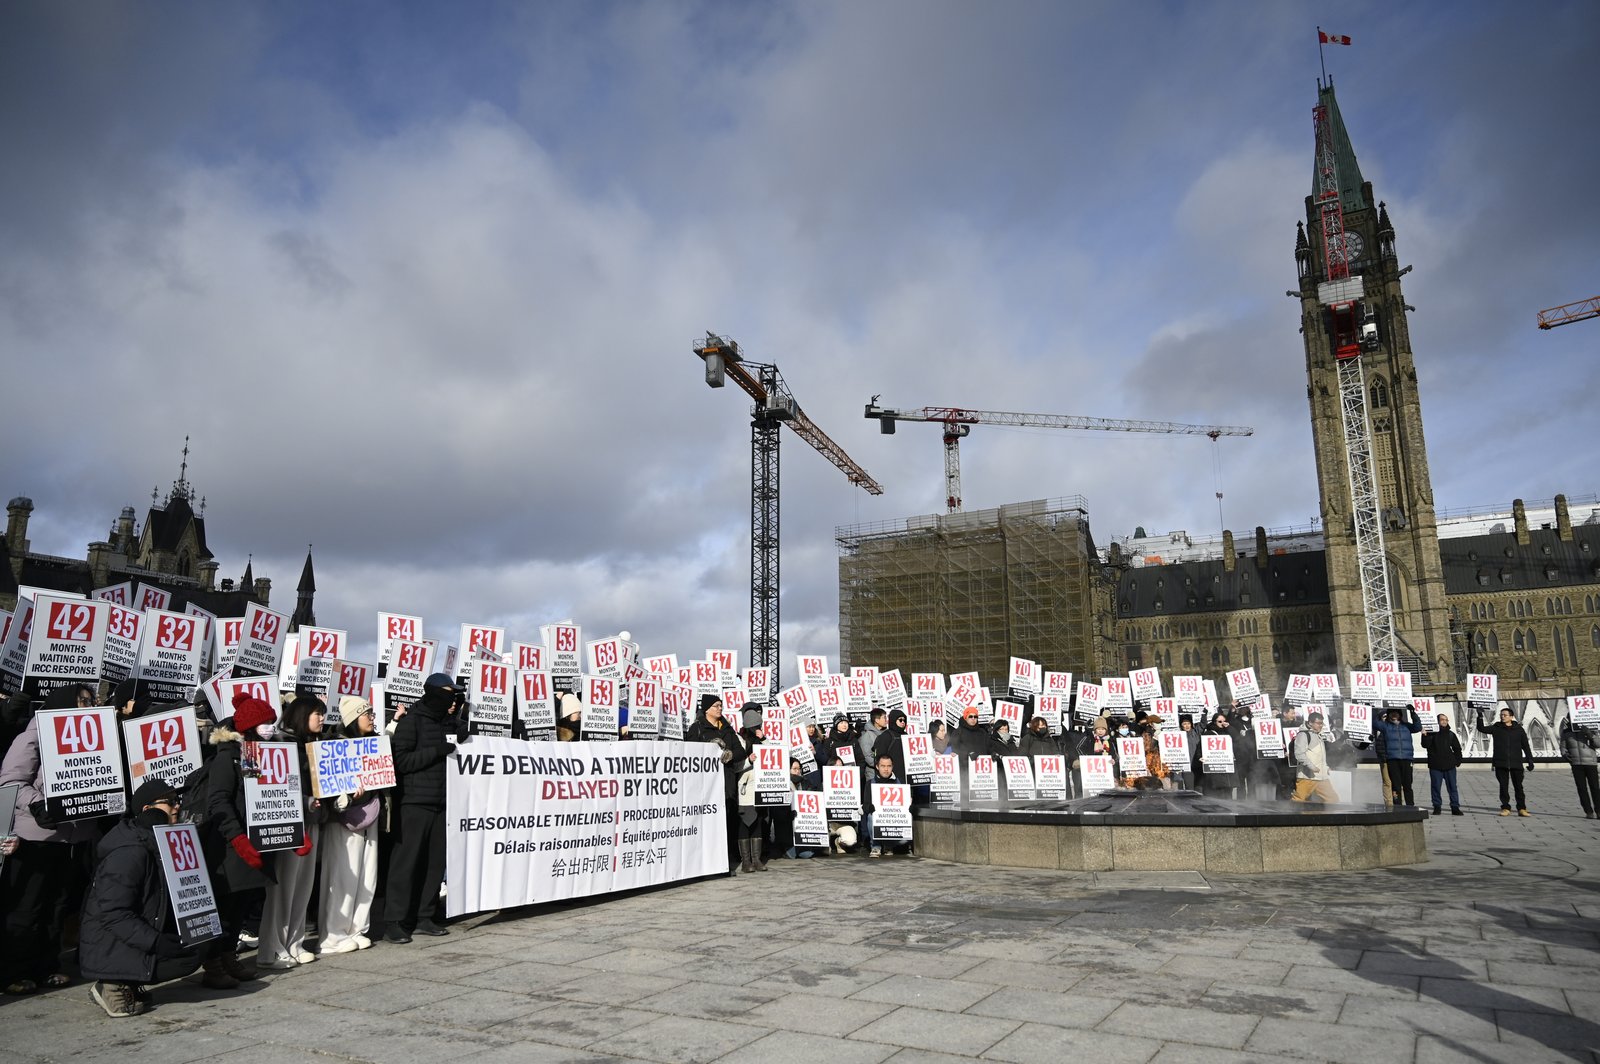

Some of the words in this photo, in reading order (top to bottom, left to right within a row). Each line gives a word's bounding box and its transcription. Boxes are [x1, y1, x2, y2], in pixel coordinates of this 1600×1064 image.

[53, 604, 90, 640] 42
[109, 608, 135, 639] 35
[254, 612, 277, 643] 42
[390, 618, 412, 641] 34
[161, 617, 190, 650] 32
[473, 629, 493, 652] 31
[559, 628, 575, 652] 53
[50, 643, 86, 654] MONTHS
[107, 636, 131, 649] MONTHS
[251, 641, 272, 654] MONTHS
[312, 632, 335, 658] 22
[40, 653, 75, 664] WAITING
[77, 656, 93, 665] FOR
[107, 653, 134, 666] RESPONS
[124, 650, 136, 659] FOR
[158, 651, 186, 662] MONTHS
[244, 648, 265, 660] WAITING
[265, 654, 275, 664] FOR
[401, 645, 421, 672] 31
[522, 646, 537, 670] 15
[597, 642, 616, 667] 68
[32, 664, 52, 673] IRCC
[52, 664, 96, 675] RESPONSE
[149, 660, 179, 671] WAITING
[180, 663, 192, 672] FOR
[238, 655, 250, 665] IRCC
[250, 659, 276, 672] RESPONSE
[304, 667, 327, 676] WAITING
[653, 659, 671, 674] 20
[807, 659, 821, 674] 43
[1016, 661, 1030, 677] 70
[143, 668, 159, 677] IRCC
[159, 669, 195, 681] RESPONSE
[300, 675, 312, 683] IRCC
[341, 666, 361, 695] 31
[399, 670, 419, 680] MONTHS
[484, 665, 503, 694] 11
[699, 664, 716, 681] 33
[749, 670, 765, 688] 38
[1234, 671, 1251, 686] 38
[1358, 674, 1375, 687] 20
[1388, 674, 1405, 687] 31
[388, 683, 400, 691] IRCC
[399, 685, 424, 695] RESPONSE
[392, 677, 412, 686] WAITING
[526, 675, 545, 700] 71
[849, 681, 865, 697] 65
[884, 673, 899, 690] 63
[919, 676, 935, 690] 27
[1051, 674, 1066, 689] 36
[1111, 680, 1124, 694] 37
[1294, 676, 1309, 689] 32
[1474, 676, 1491, 689] 30
[592, 680, 611, 706] 53
[638, 682, 654, 706] 34
[728, 691, 744, 709] 34
[786, 687, 806, 708] 30
[821, 689, 837, 706] 55
[955, 685, 976, 706] 35
[1083, 685, 1097, 700] 28
[663, 692, 678, 716] 51
[908, 700, 921, 716] 72
[930, 702, 943, 718] 23
[1041, 697, 1056, 712] 31
[1158, 700, 1172, 714] 31
[1415, 699, 1430, 712] 37
[1575, 697, 1594, 710] 23
[1003, 704, 1017, 720] 11
[1351, 705, 1366, 720] 40
[61, 715, 99, 752] 40
[765, 721, 782, 740] 33
[1262, 721, 1276, 736] 37
[147, 718, 182, 757] 42
[1166, 733, 1181, 748] 37
[1210, 737, 1225, 751] 37
[321, 740, 349, 759] STOP
[353, 738, 378, 756] THE
[910, 737, 927, 755] 34
[1125, 740, 1139, 755] 37
[64, 755, 102, 768] MONTHS
[150, 755, 184, 771] MONTHS
[261, 748, 287, 784] 40
[457, 754, 495, 776] WE
[502, 754, 585, 777] DEMAND
[590, 757, 603, 775] A
[605, 756, 660, 775] TIMELY
[663, 756, 720, 774] DECISION
[762, 749, 780, 770] 41
[937, 758, 953, 774] 35
[976, 758, 991, 774] 18
[1010, 759, 1026, 774] 36
[1043, 758, 1058, 773] 21
[1089, 758, 1105, 773] 14
[56, 768, 93, 780] WAITING
[95, 765, 112, 776] FOR
[142, 768, 177, 782] WAITING
[178, 762, 194, 774] FOR
[833, 770, 851, 788] 40
[51, 782, 72, 793] IRCC
[73, 775, 118, 790] RESPONSE
[542, 779, 620, 800] DELAYED
[624, 778, 643, 797] BY
[646, 777, 678, 796] IRCC
[62, 799, 73, 807] NO
[73, 793, 107, 805] TIMELINE
[261, 789, 288, 799] MONTHS
[882, 787, 901, 806] 22
[66, 807, 77, 816] NO
[78, 802, 108, 814] RESULTS
[255, 800, 282, 810] WAITING
[283, 799, 295, 808] FOR
[800, 794, 817, 813] 43
[252, 812, 267, 821] IRCC
[267, 810, 299, 821] RESPONSE
[460, 814, 552, 833] REASONABLE
[554, 811, 614, 827] TIMELINES
[623, 806, 681, 822] PROCEDURAL
[681, 803, 718, 817] FAIRNESS
[259, 828, 268, 836] NO
[268, 826, 295, 835] TIMELINES
[262, 838, 271, 846] NO
[271, 835, 293, 844] RESULTS
[494, 839, 536, 855] Délais
[539, 834, 612, 851] raisonnables
[622, 828, 651, 845] Équité
[651, 825, 698, 843] procédurale
[169, 831, 196, 871] 36
[552, 854, 610, 878] 给出时限
[621, 847, 667, 869] 程序公平
[180, 874, 200, 887] MONTHS
[177, 887, 198, 900] WAITING
[198, 885, 208, 896] FOR
[177, 902, 189, 913] IRCC
[188, 896, 213, 911] RESPONSE
